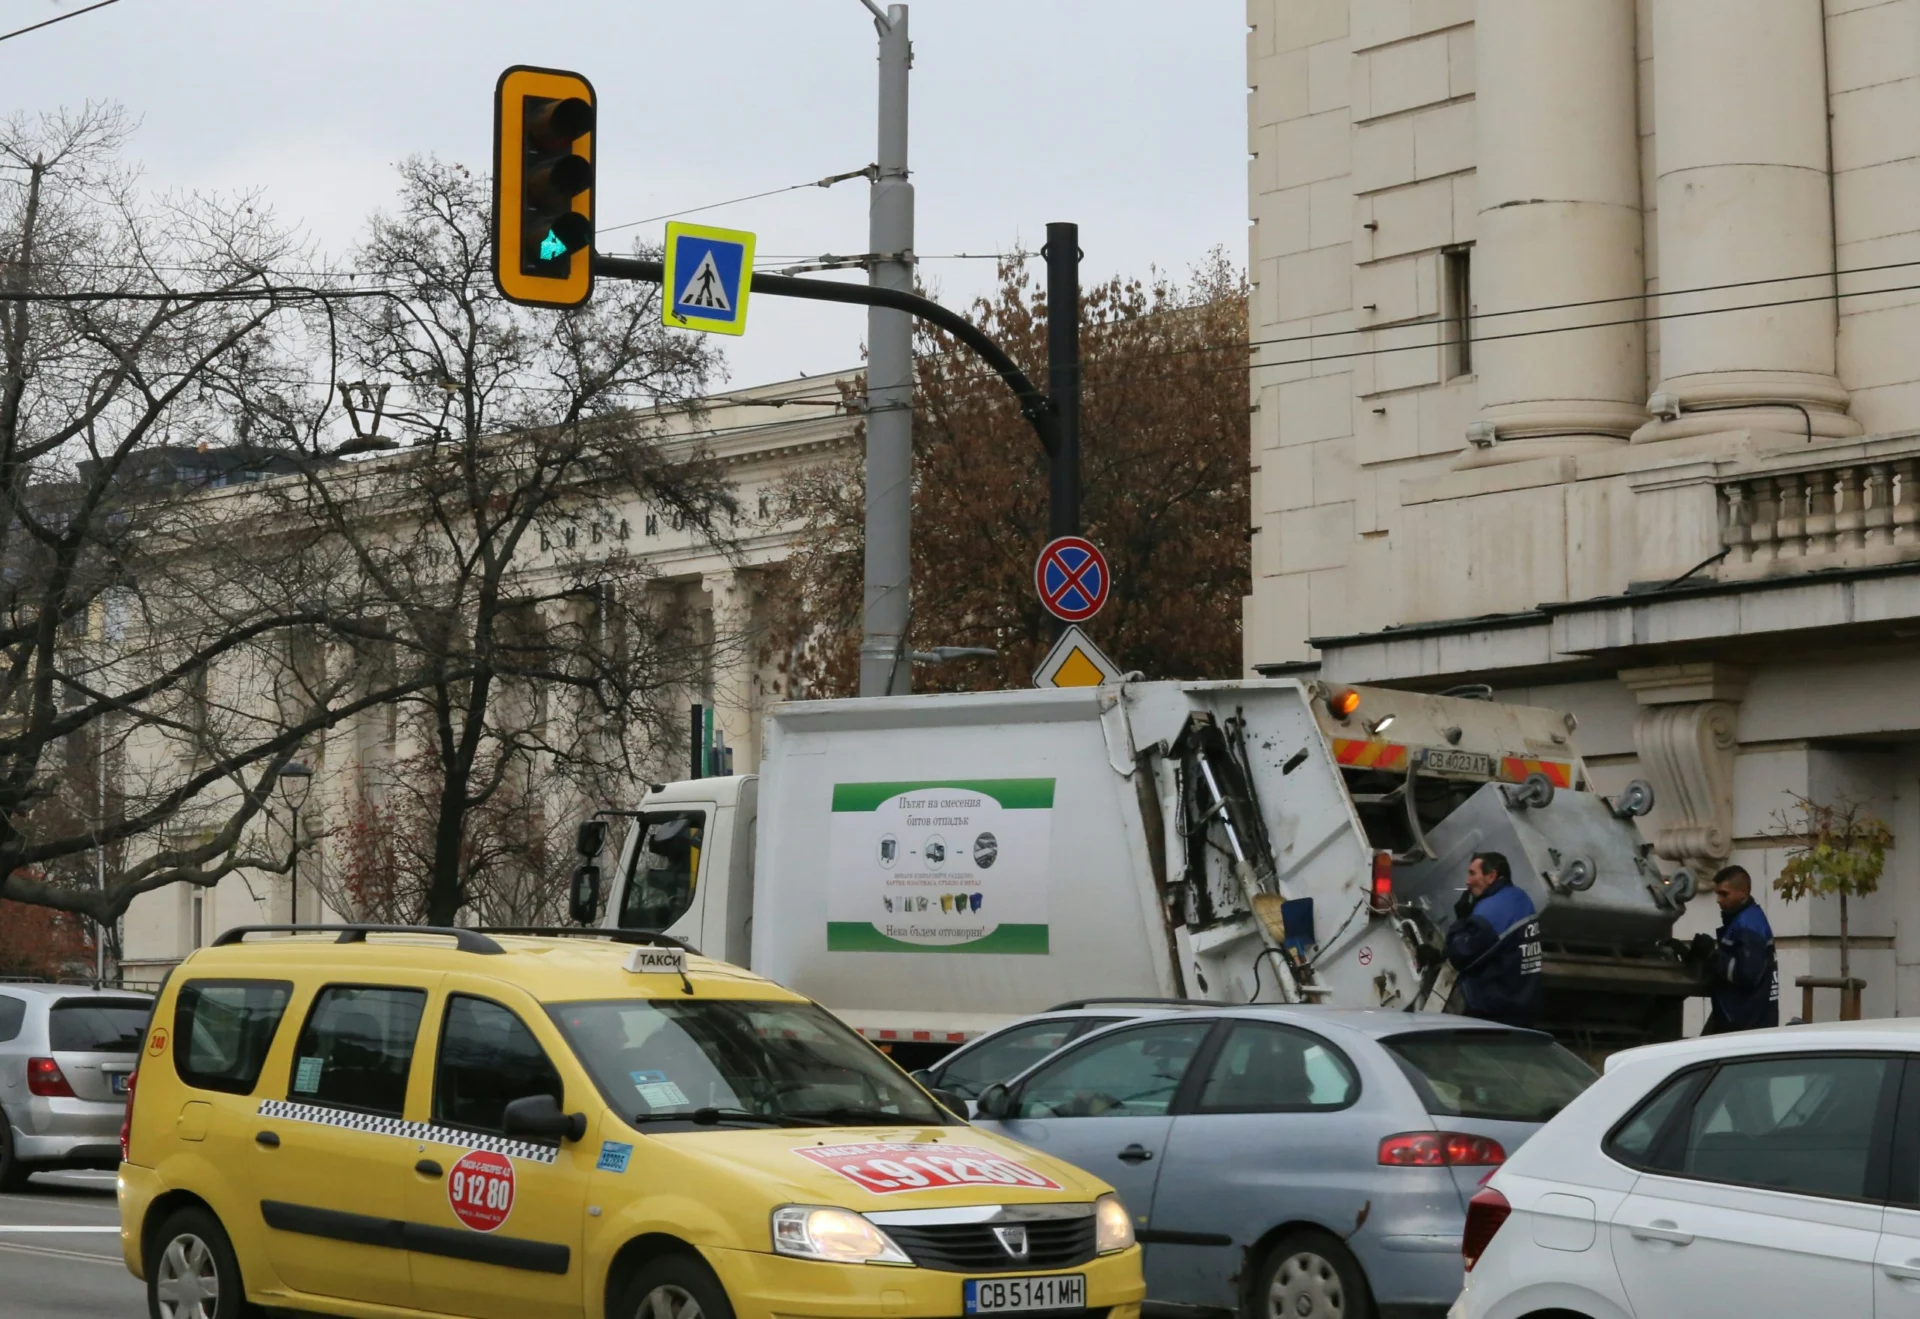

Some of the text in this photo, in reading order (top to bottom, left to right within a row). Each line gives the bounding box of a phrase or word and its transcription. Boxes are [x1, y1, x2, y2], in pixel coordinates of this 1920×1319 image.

[899, 797, 981, 809] Пътят на смесения
[907, 814, 969, 827] битов отпадък
[886, 925, 908, 936] Нека
[910, 925, 936, 937] бъдем
[640, 955, 682, 966] ТАКСИ
[980, 1279, 1082, 1308] CB 5141 MH
